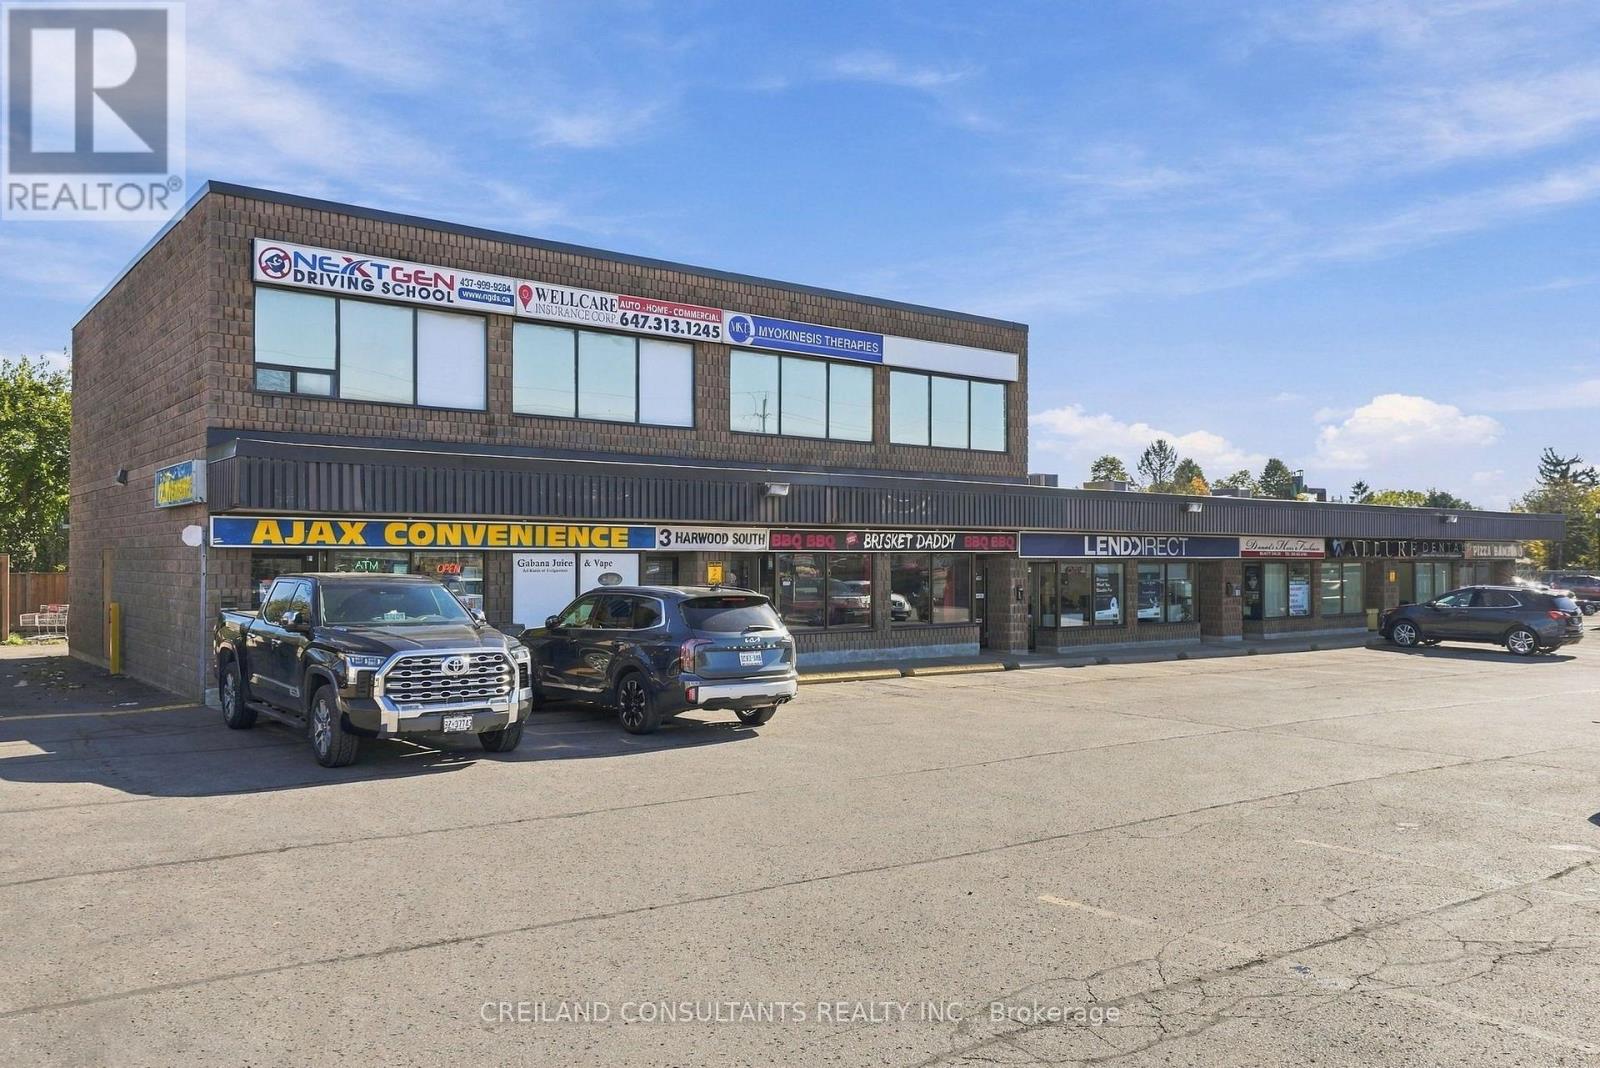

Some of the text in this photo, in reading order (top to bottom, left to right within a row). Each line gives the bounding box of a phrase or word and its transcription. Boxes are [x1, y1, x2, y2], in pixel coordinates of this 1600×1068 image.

[293, 250, 455, 291] NEXTGEN
[293, 269, 454, 303] DRIVING SCHOOL
[535, 287, 618, 313] WELLCARE
[535, 303, 618, 325] INSURANCE CORP.
[620, 300, 641, 310] AUTO
[646, 304, 668, 315] HOME
[673, 308, 720, 322] COMMERCIAL
[620, 312, 720, 338] 647.313.1245
[758, 326, 879, 353] MYOKINESIS THERAPIES
[251, 519, 630, 548] AJAX CONVENIENCE
[659, 528, 766, 547] 3 HARWOOD SOUTH
[771, 533, 836, 550] BBQ BBQ
[864, 533, 956, 549] BRISKET DADDY
[964, 536, 1014, 550] BBQ BBQ
[1473, 545, 1491, 556] PIZZA
[355, 560, 379, 571] ATM
[436, 563, 462, 574] OPEN
[517, 559, 573, 568] Gabana Juice
[584, 559, 613, 569] & Vape
